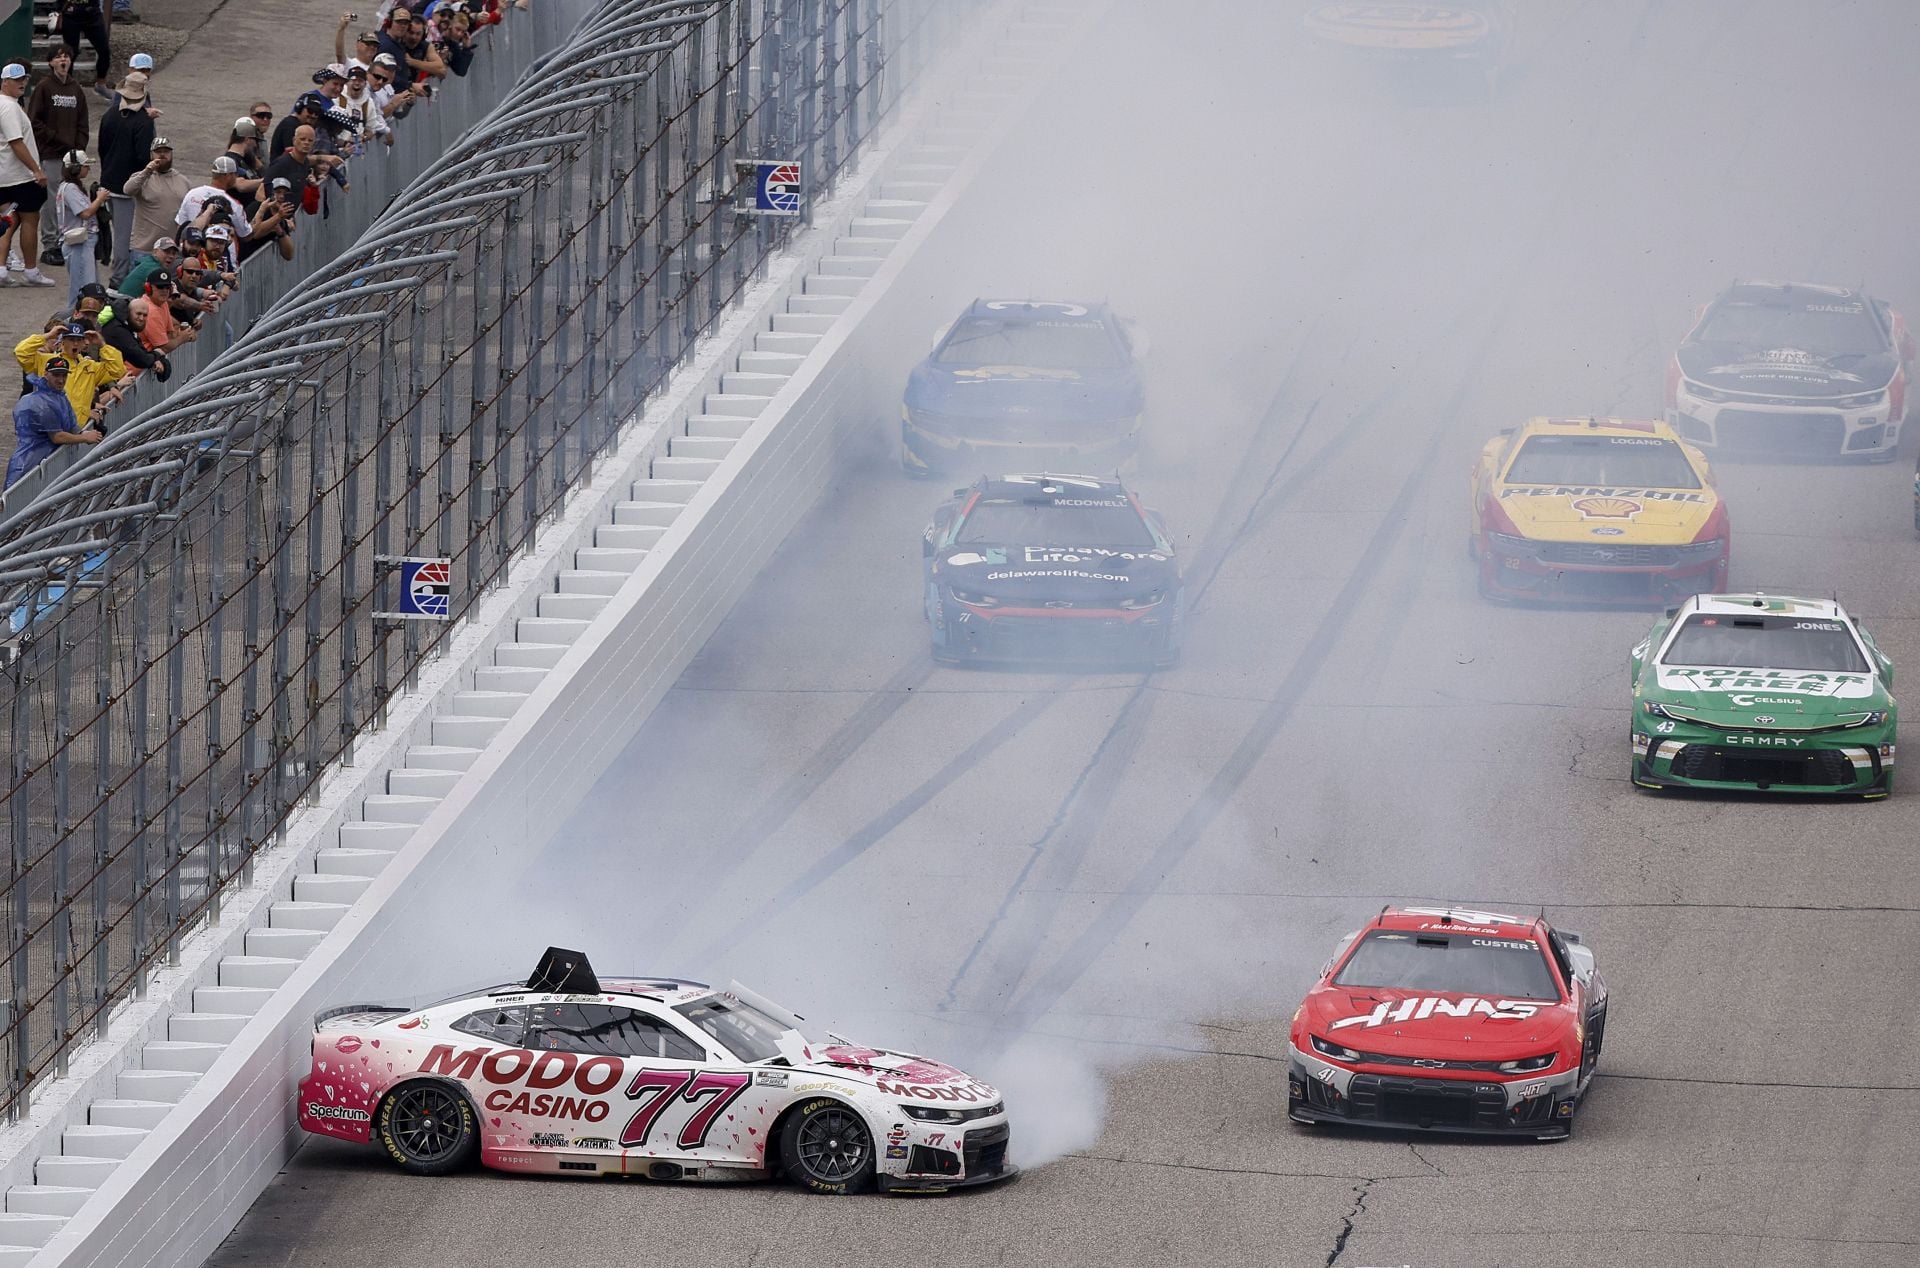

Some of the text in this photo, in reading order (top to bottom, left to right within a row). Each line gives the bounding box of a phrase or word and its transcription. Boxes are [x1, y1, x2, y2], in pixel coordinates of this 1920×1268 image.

[1611, 437, 1663, 446] LOGANO
[1054, 498, 1128, 507] MCDOWELL
[1501, 487, 1709, 504] PENNZOIL
[987, 569, 1130, 582] delawarelife.com
[1793, 622, 1842, 631] JONES
[1666, 668, 1868, 685] DOLLAR
[1704, 677, 1830, 693] TREE
[1656, 722, 1676, 733] 43
[1726, 735, 1806, 747] CAMRY
[1472, 939, 1529, 951] CUSTER
[417, 1044, 625, 1096] MODO
[1317, 1068, 1337, 1082] 41
[793, 1082, 857, 1096] GOODYEAR
[876, 1081, 978, 1102] MODO
[309, 1103, 365, 1121] Spectrum
[484, 1089, 609, 1122] CASINO
[618, 1067, 754, 1151] 77
[457, 1099, 472, 1135] EAGLE
[379, 1095, 407, 1164] GOODYEAR
[928, 1133, 946, 1146] 77
[498, 1155, 533, 1164] respect
[808, 1180, 847, 1192] EAGLE
